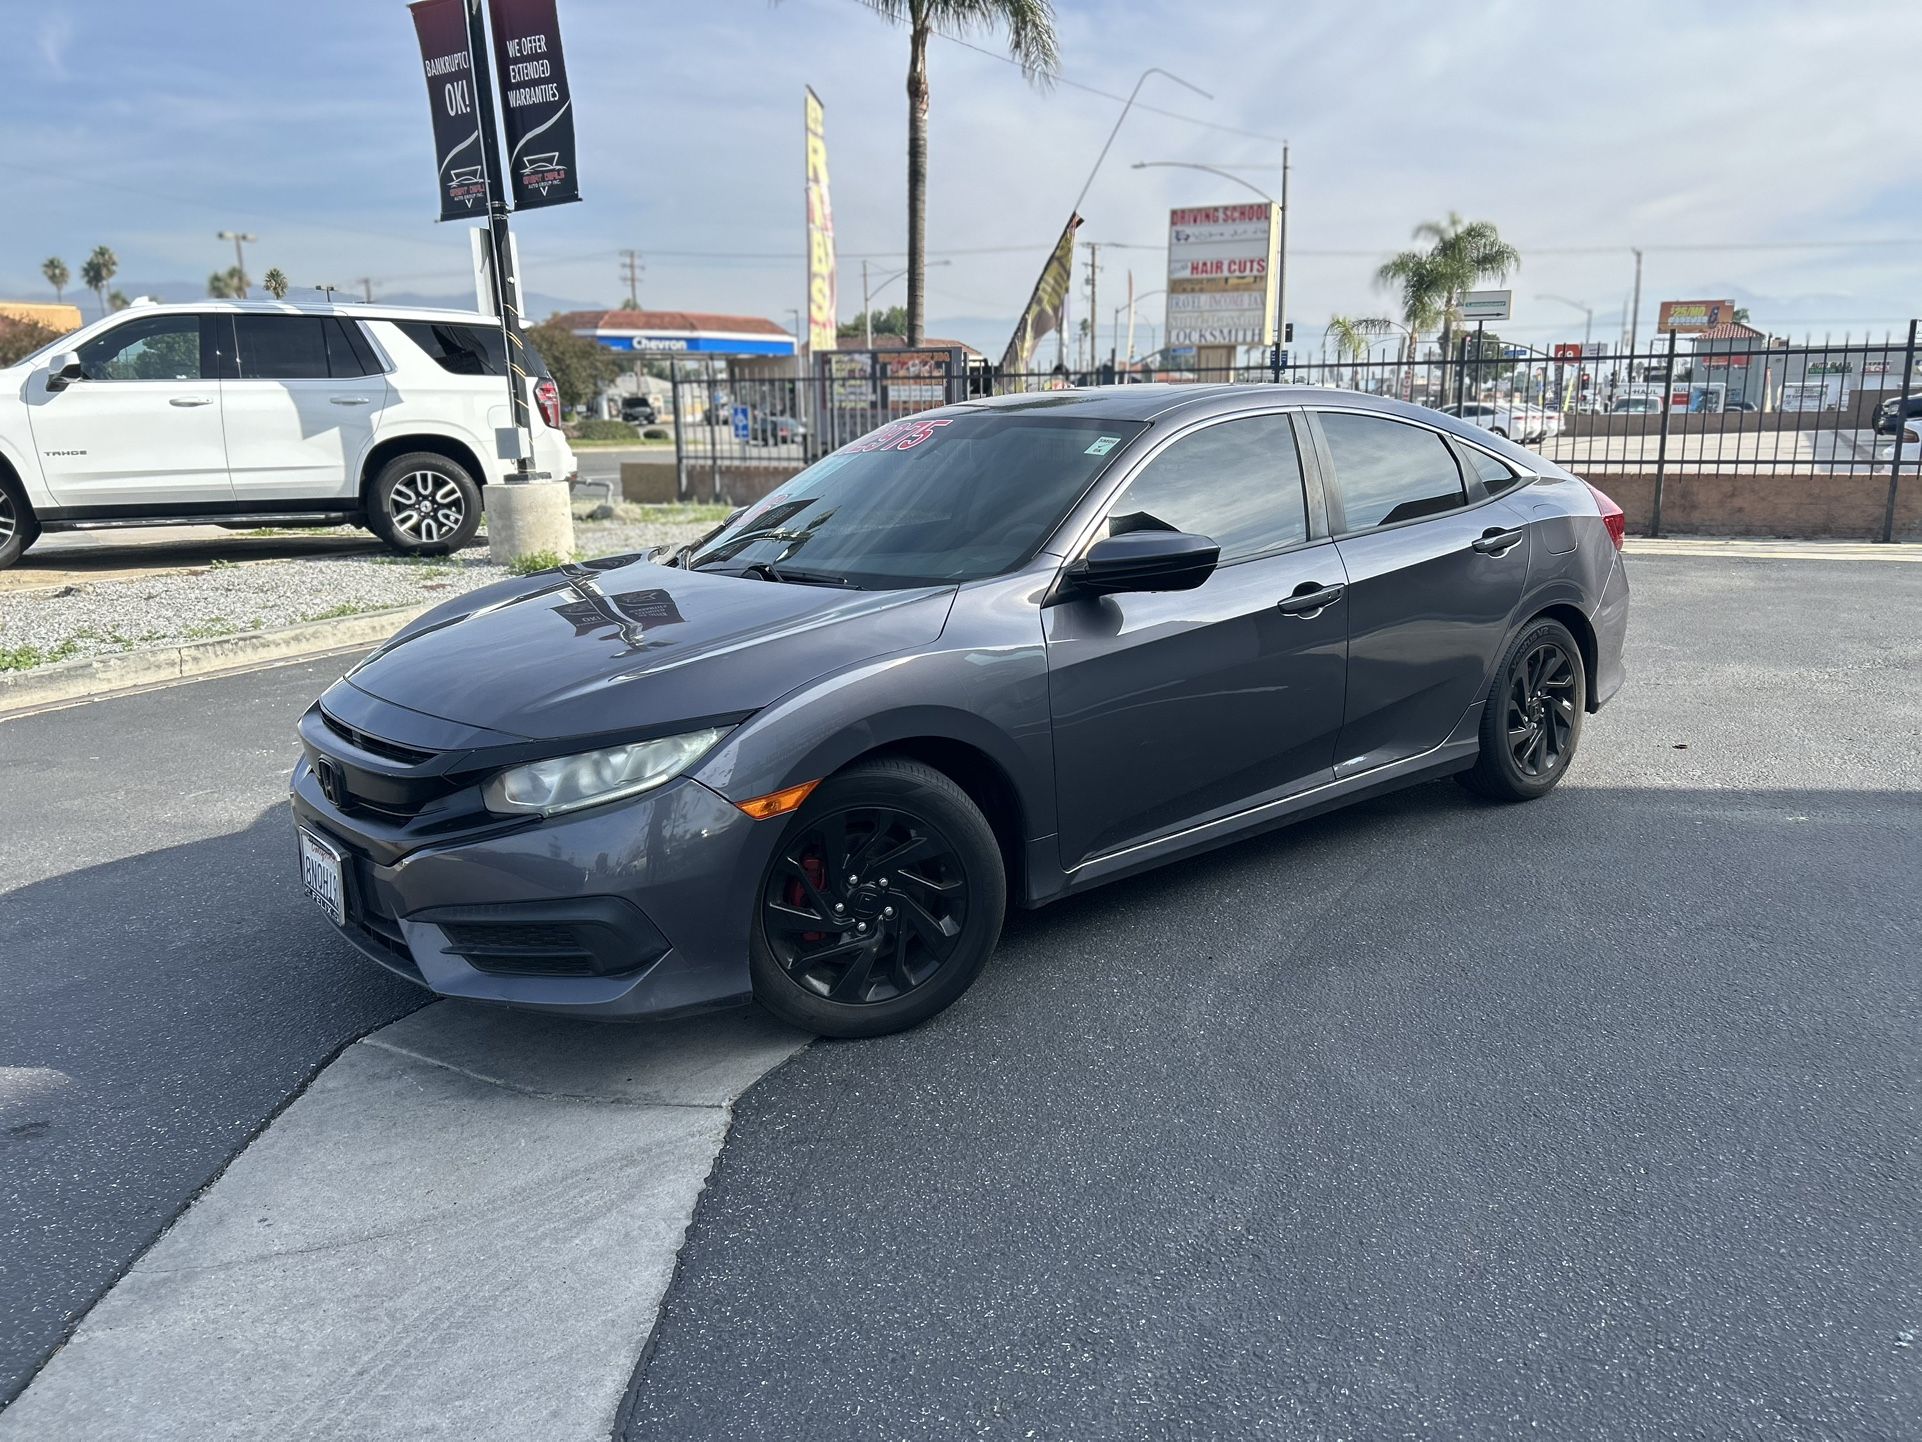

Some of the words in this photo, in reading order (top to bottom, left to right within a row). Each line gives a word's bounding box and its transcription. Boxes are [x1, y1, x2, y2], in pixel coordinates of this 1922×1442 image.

[507, 39, 521, 58] WE
[521, 34, 547, 55] OFFER
[509, 60, 550, 83] EXTENDED
[444, 79, 471, 117] OK!
[508, 84, 558, 107] WARRANTIES
[1171, 210, 1219, 226] DRIVING
[1222, 204, 1270, 222] SCHOOL
[1190, 260, 1224, 275] HAIR
[1227, 258, 1266, 274] CUTS
[632, 336, 688, 351] Chevron
[1168, 328, 1263, 344] LOCKSMITH
[311, 892, 332, 917] FELIX
